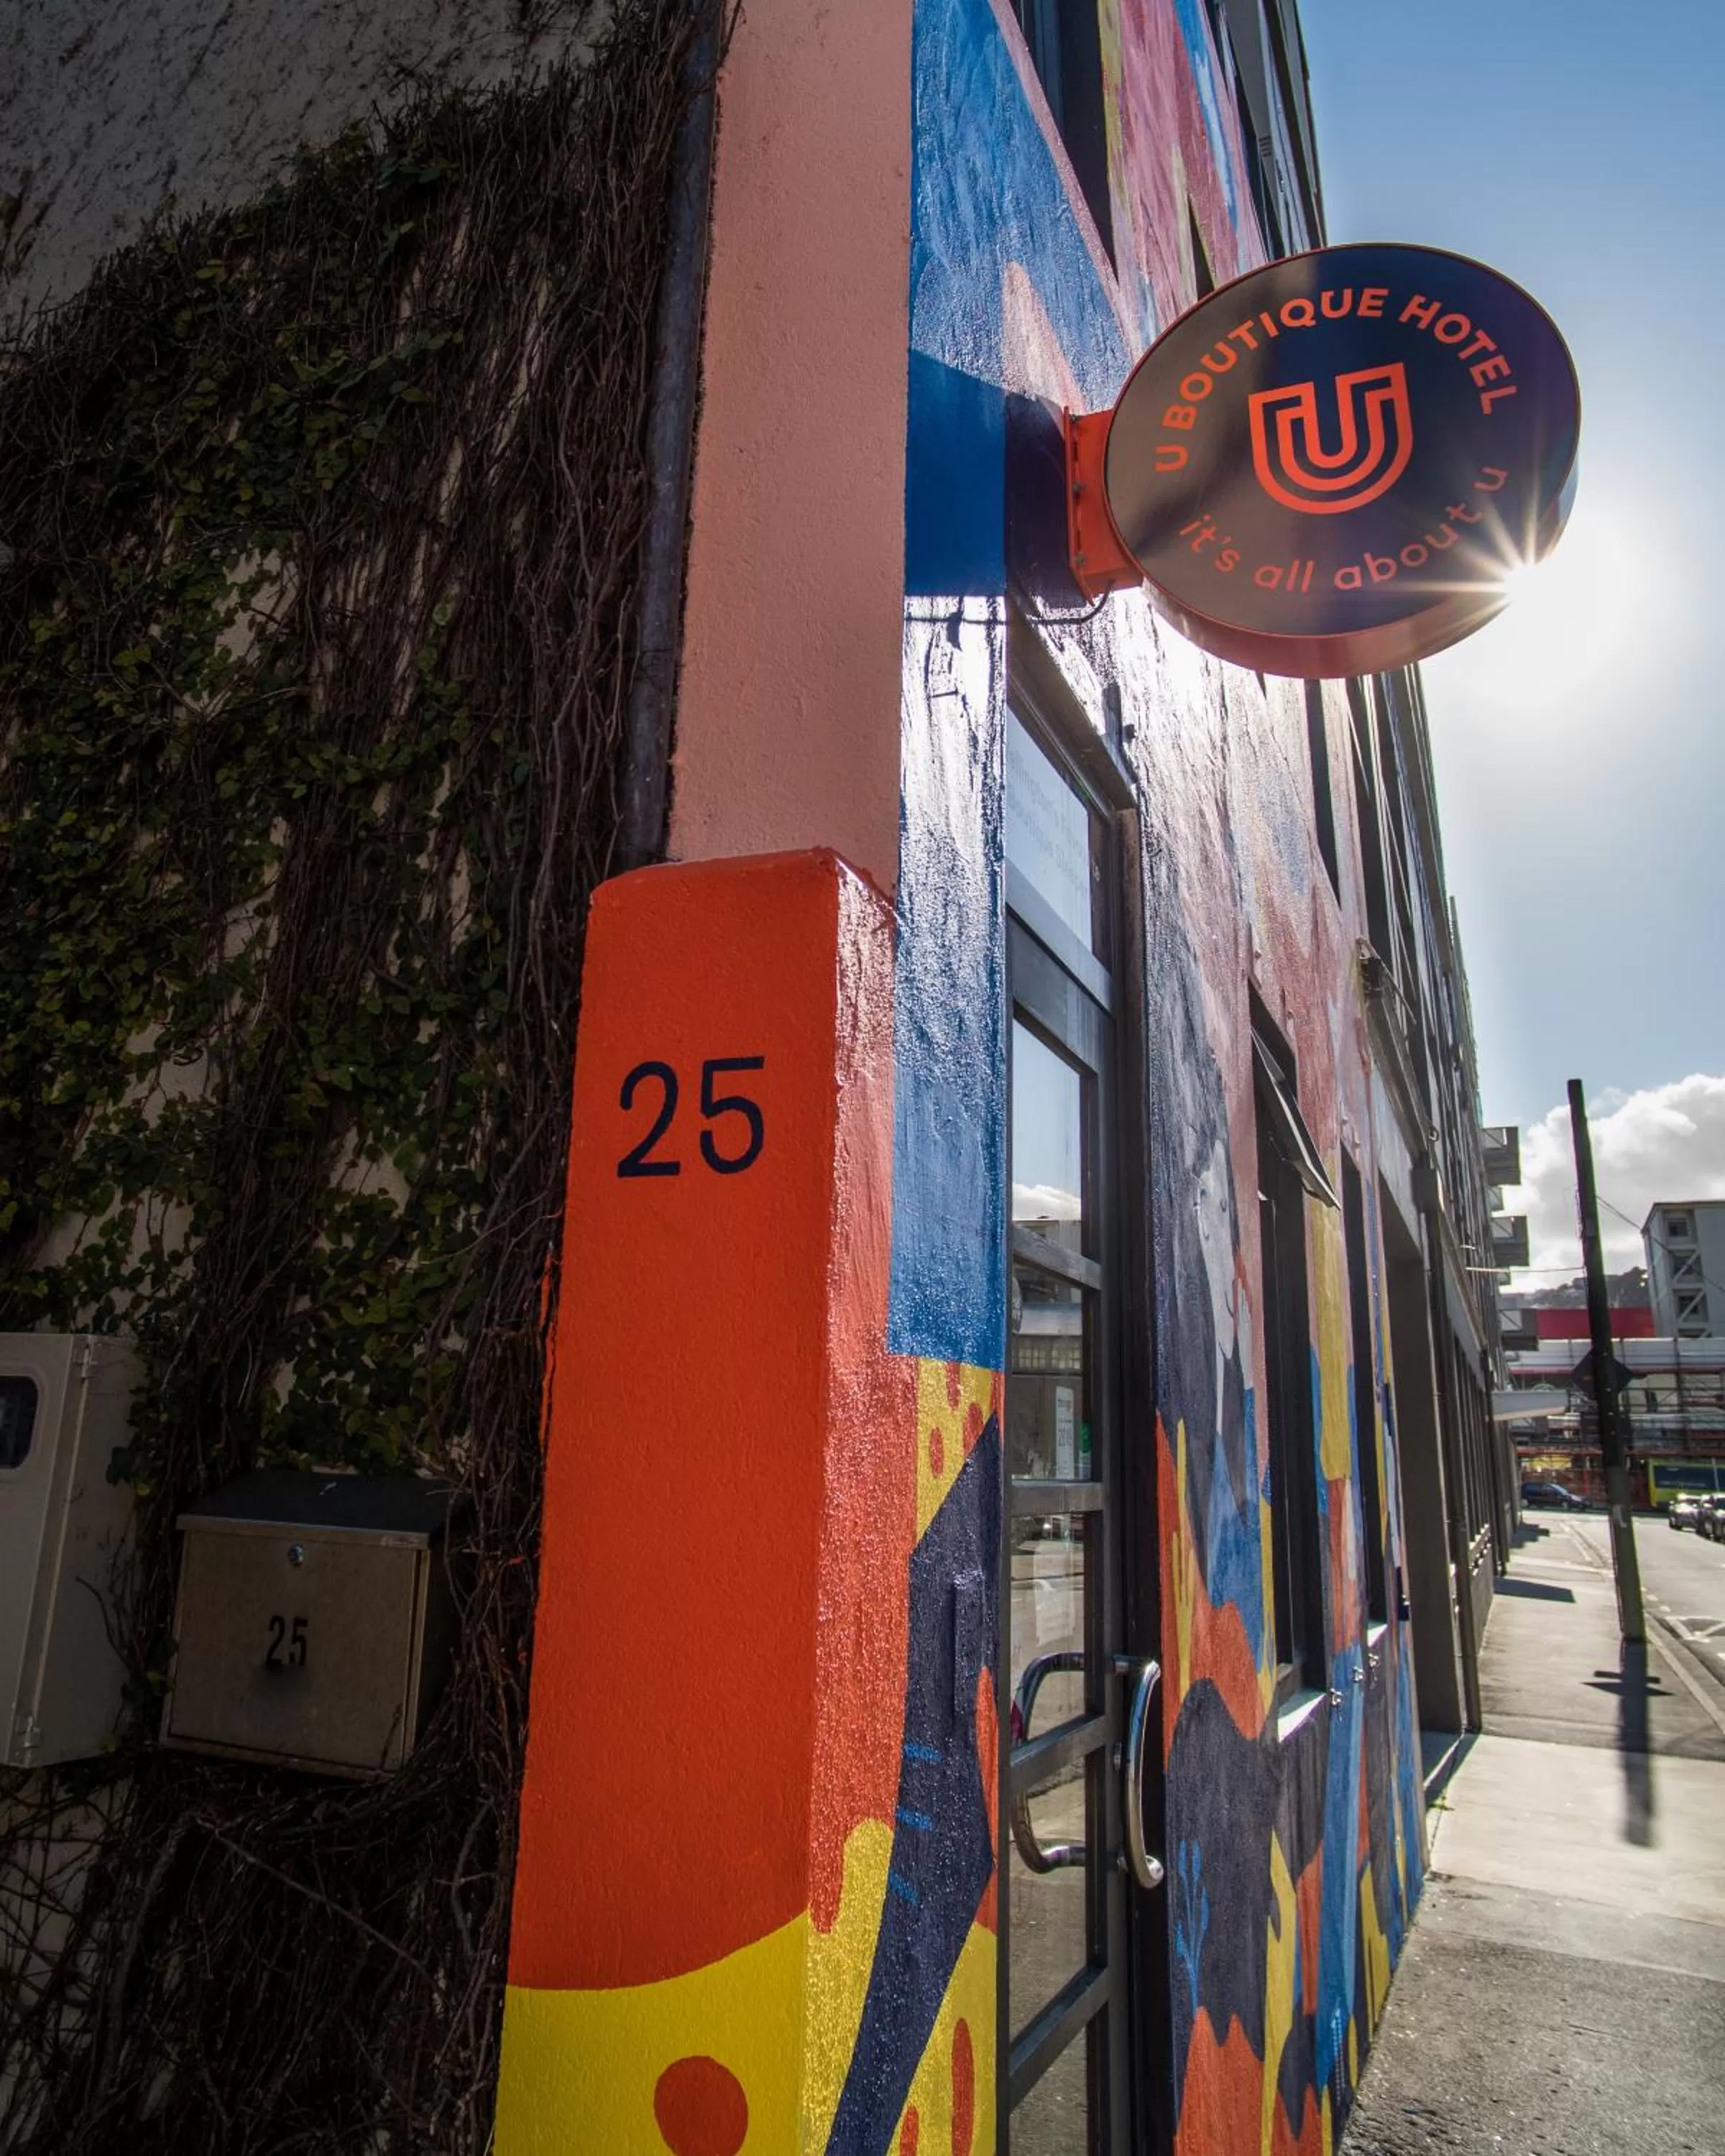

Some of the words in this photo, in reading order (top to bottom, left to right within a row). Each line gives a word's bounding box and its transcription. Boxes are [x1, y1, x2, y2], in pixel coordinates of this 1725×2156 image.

[1163, 288, 1389, 430] BOUTIQUE
[1399, 295, 1517, 414] HOTEL
[1155, 446, 1188, 471] U
[1179, 515, 1241, 572] it's
[1254, 560, 1315, 593] all
[1334, 501, 1481, 590] about
[1474, 466, 1507, 492] u
[617, 1055, 765, 1178] 25
[264, 1615, 308, 1668] 25
